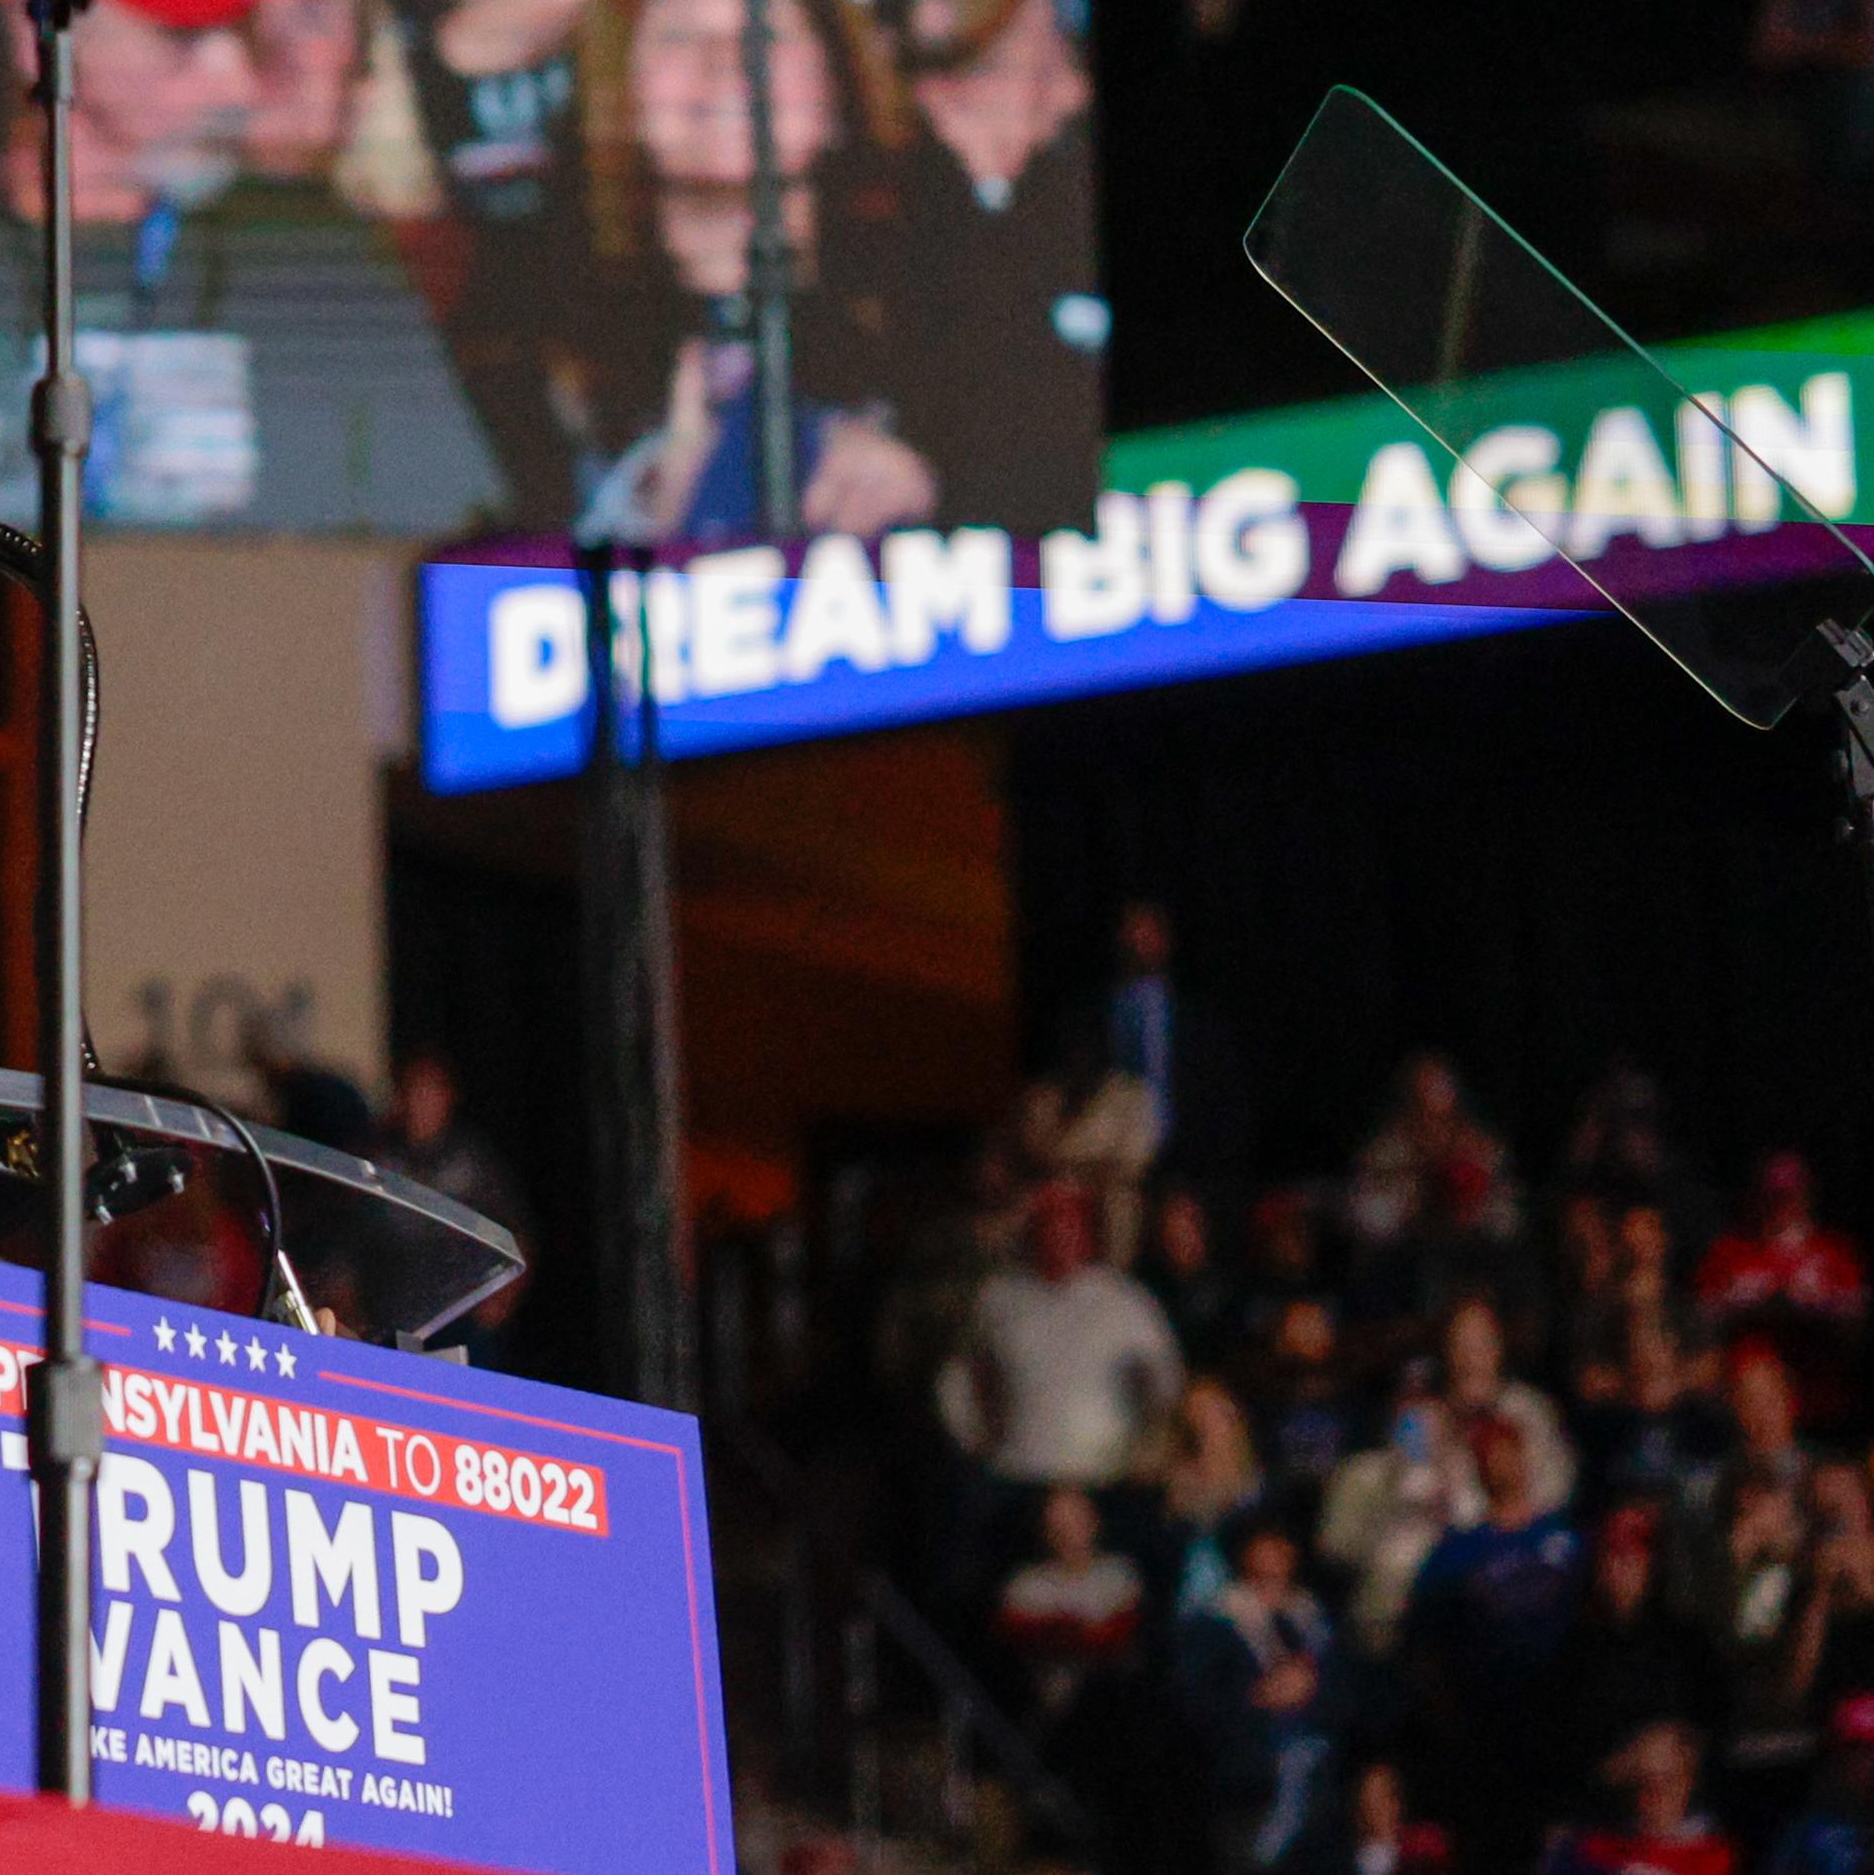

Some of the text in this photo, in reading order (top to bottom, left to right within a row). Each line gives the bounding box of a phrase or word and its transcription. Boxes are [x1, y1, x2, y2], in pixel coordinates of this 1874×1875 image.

[490, 371, 1856, 728] DREAM BIG AGAIN
[1, 1430, 464, 1648] RUMP
[375, 1426, 442, 1497] TO
[453, 1443, 599, 1530] 88022
[89, 1600, 427, 1766] VANCE
[90, 1725, 453, 1819] KE AMERICA GREAT AGAIN!
